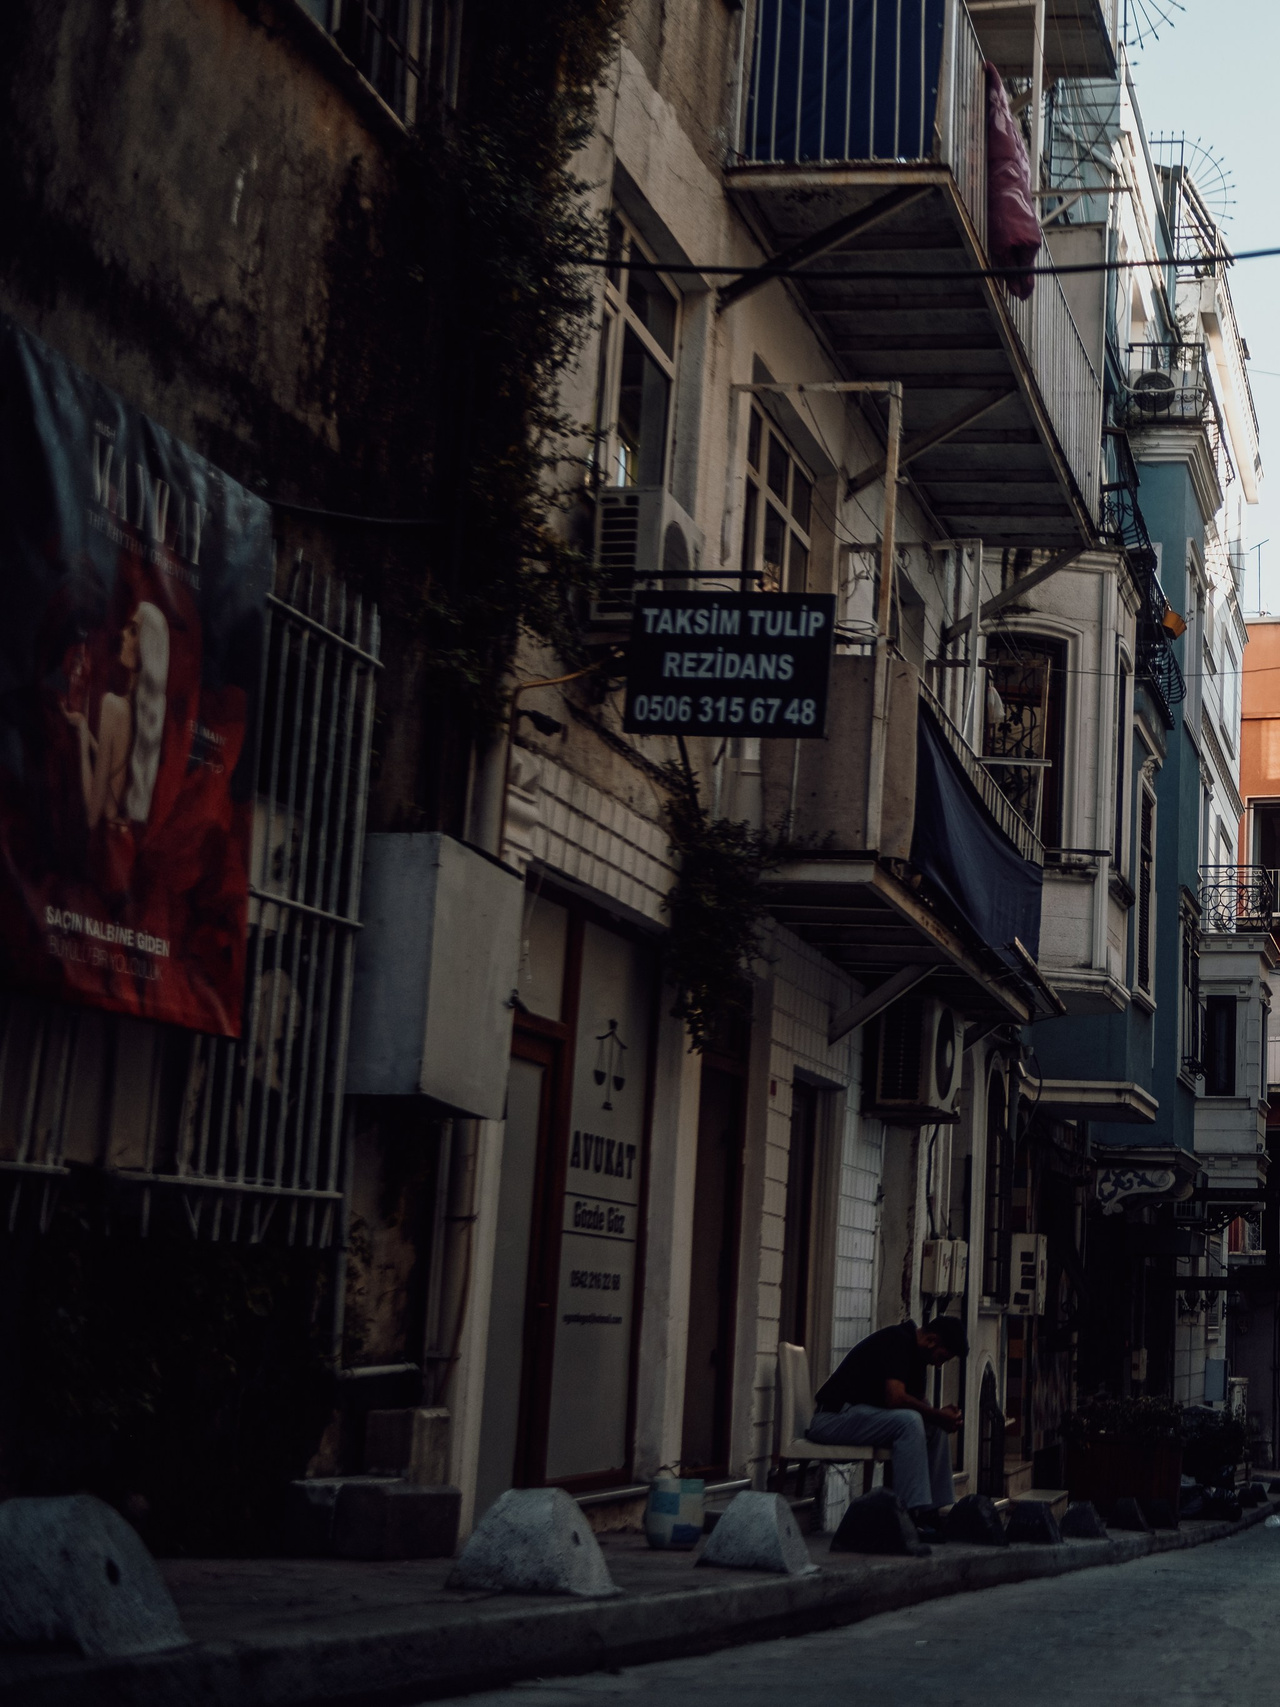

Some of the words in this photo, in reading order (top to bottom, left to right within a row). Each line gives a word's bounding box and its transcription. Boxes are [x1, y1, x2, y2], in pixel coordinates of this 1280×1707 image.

[641, 602, 741, 636] TAKSİM
[748, 604, 826, 637] TULİP
[662, 646, 794, 681] REZİDANS
[633, 694, 692, 723] 0506
[698, 696, 744, 724] 315
[749, 697, 782, 725] 67
[783, 698, 817, 726] 48
[46, 905, 83, 934] SAÇIN
[85, 916, 136, 947] KALBİNE
[136, 930, 171, 958] GİDEN
[570, 1130, 636, 1180] AVUKAT
[574, 1201, 605, 1230] Gözde
[607, 1206, 626, 1234] Göz
